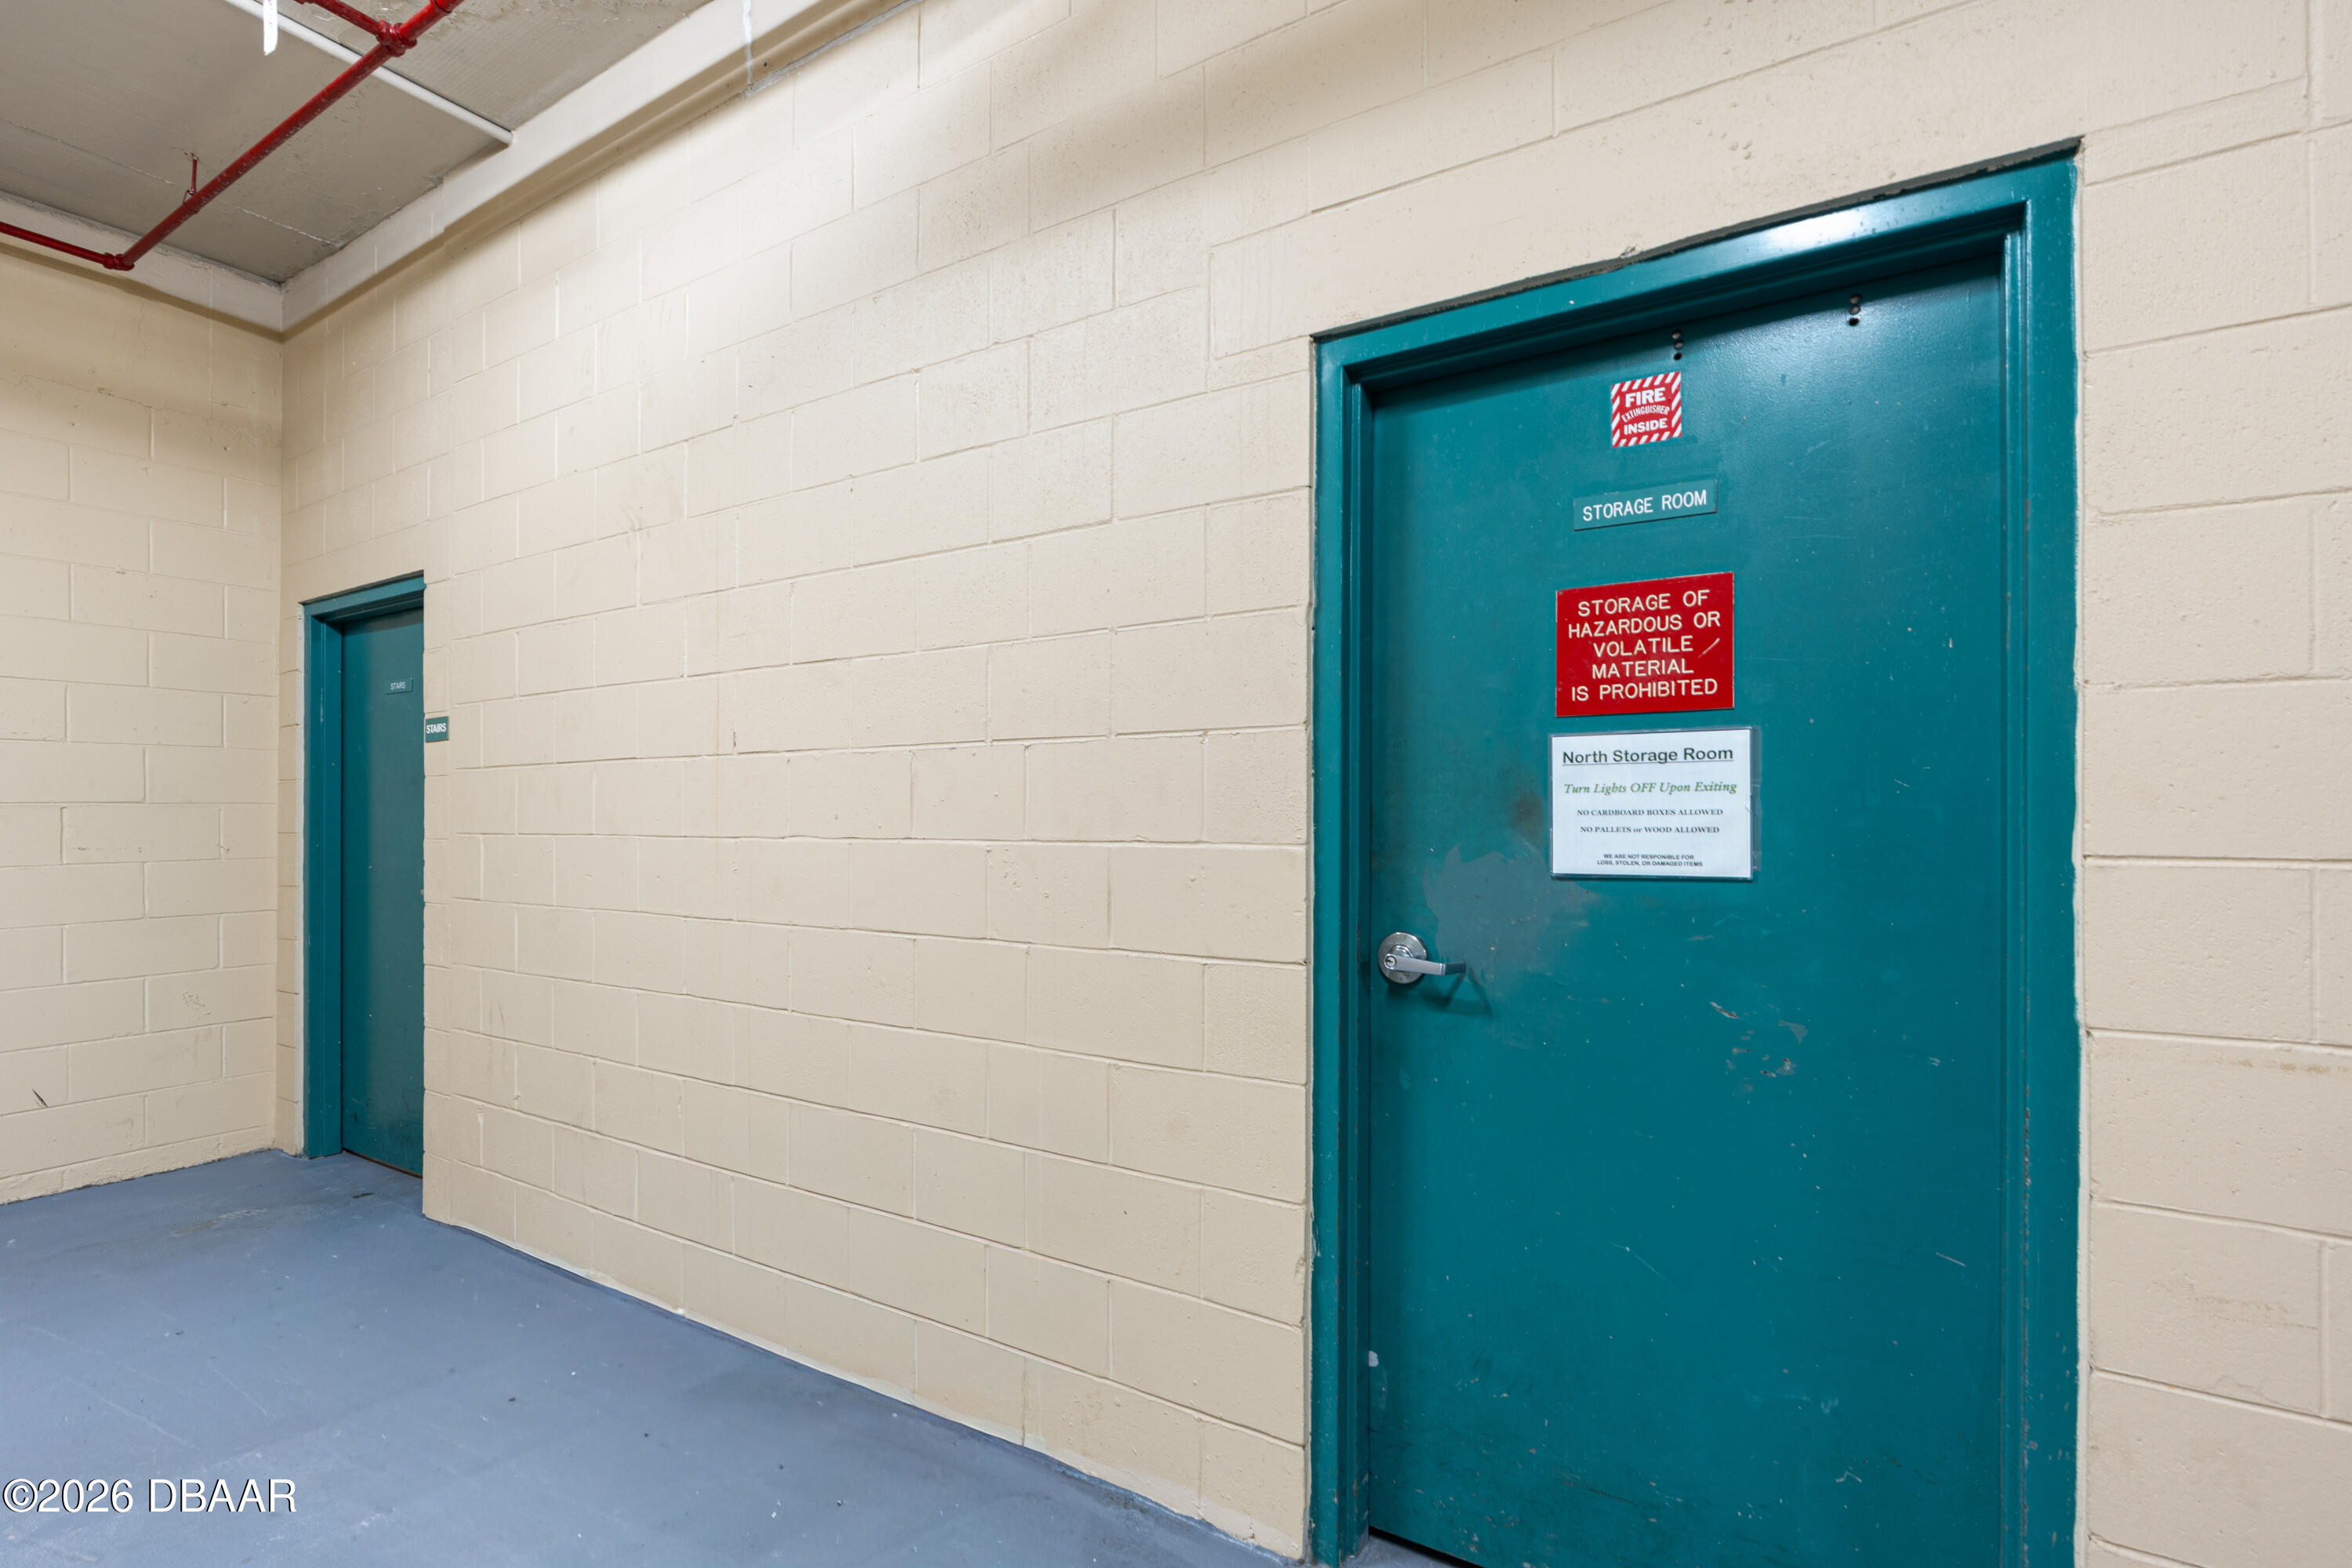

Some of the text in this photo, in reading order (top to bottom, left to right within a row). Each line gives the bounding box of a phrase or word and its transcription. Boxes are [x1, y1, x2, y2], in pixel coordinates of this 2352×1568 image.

[1625, 387, 1665, 408] FIRE
[1621, 405, 1670, 423] EXTINGUISHER
[1624, 418, 1668, 435] INSIDE
[1582, 489, 1707, 521] STORAGE ROOM
[1577, 590, 1710, 617] STORAGE OF
[1569, 611, 1721, 638] HAZARDOUS OR
[1593, 635, 1693, 657] VOLATILE
[1592, 659, 1694, 680] MATERIAL
[390, 681, 406, 690] STAIRS
[1571, 678, 1718, 702] IS PROHIBITED
[426, 723, 447, 734] STAIRS
[1563, 748, 1733, 764] North Storage Room
[1564, 782, 1737, 795] Turn Lights OFF Upon Exiting
